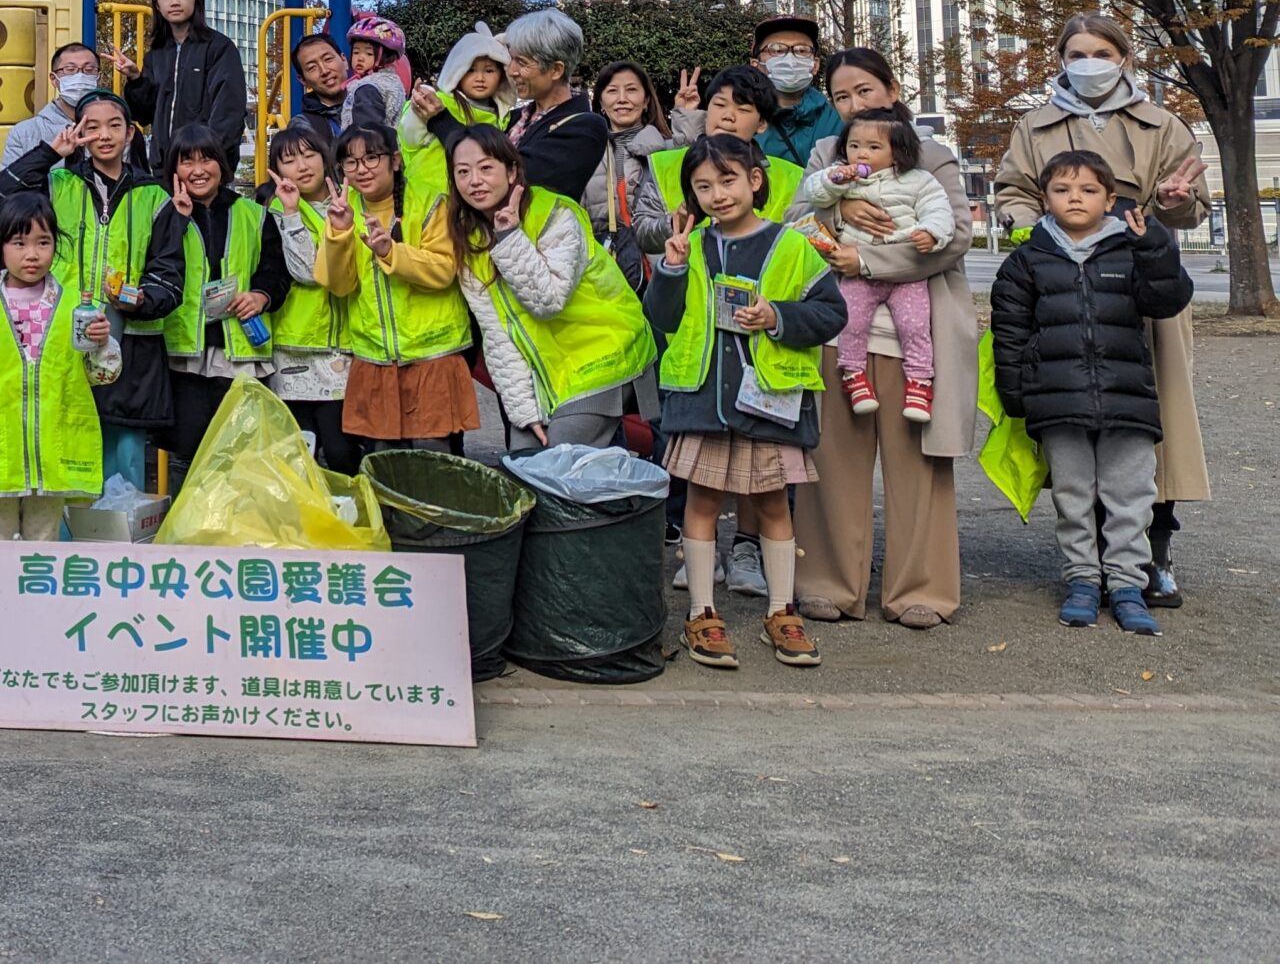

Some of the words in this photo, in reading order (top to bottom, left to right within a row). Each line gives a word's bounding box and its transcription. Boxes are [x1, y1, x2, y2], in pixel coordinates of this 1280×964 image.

[18, 553, 414, 608] 高島中央公園愛護会
[64, 612, 373, 661] イベント開催中
[81, 702, 353, 731] スタッフにお声かけください。
